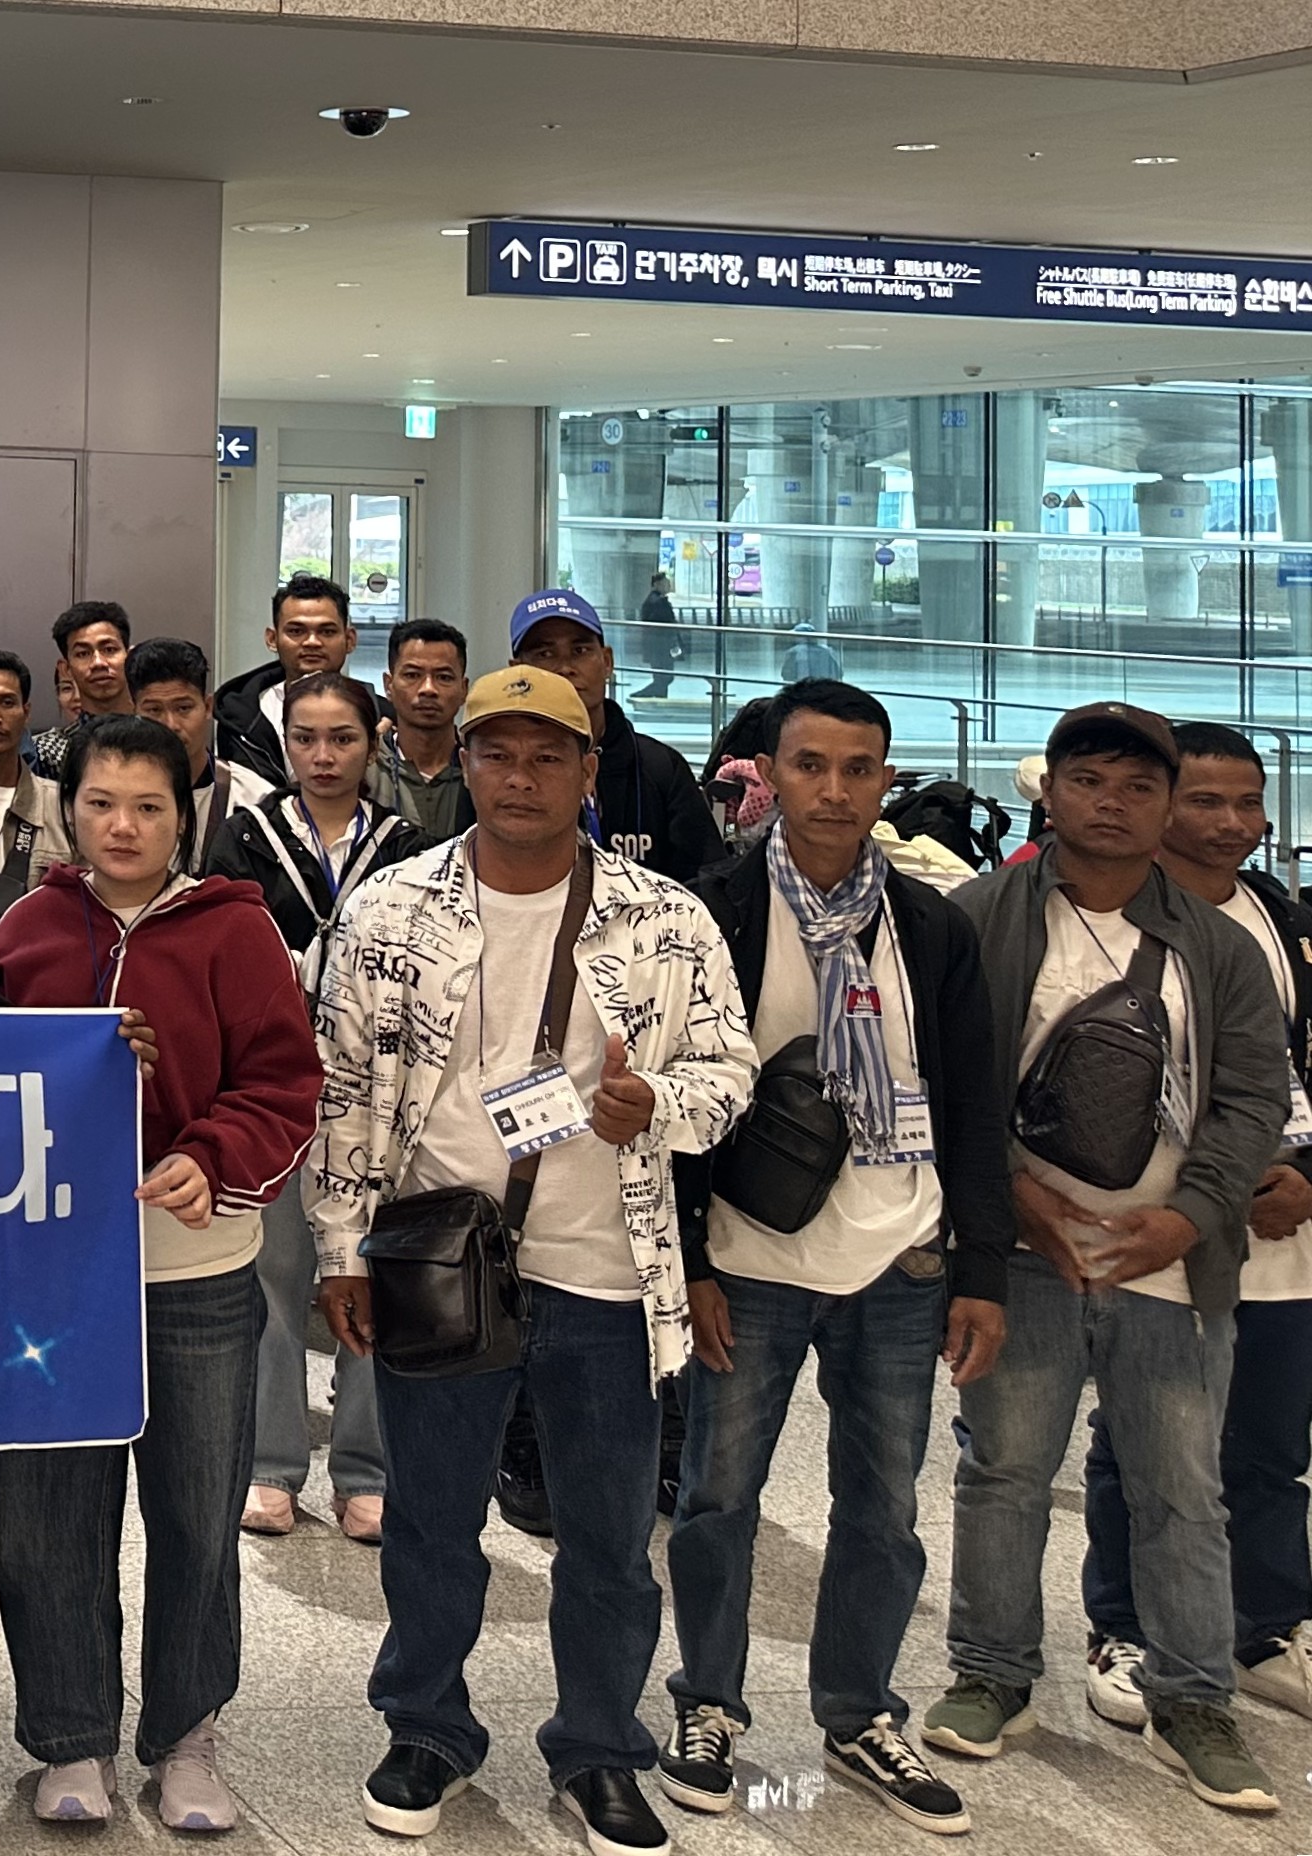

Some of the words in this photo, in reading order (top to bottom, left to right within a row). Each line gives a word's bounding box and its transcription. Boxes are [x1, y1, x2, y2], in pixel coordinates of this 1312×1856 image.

[549, 244, 574, 278] P
[595, 244, 618, 255] TAXI
[635, 250, 749, 288] 단기주차장,
[757, 256, 798, 287] 택시
[804, 275, 839, 293] Short
[842, 278, 872, 294] Term
[875, 280, 926, 300] Parking,
[928, 283, 953, 298] Taxi
[1036, 286, 1062, 304] Free
[1063, 287, 1105, 307] Shuttle
[1159, 292, 1188, 310] Term
[1190, 294, 1238, 317] Parking)
[603, 423, 621, 440] 30
